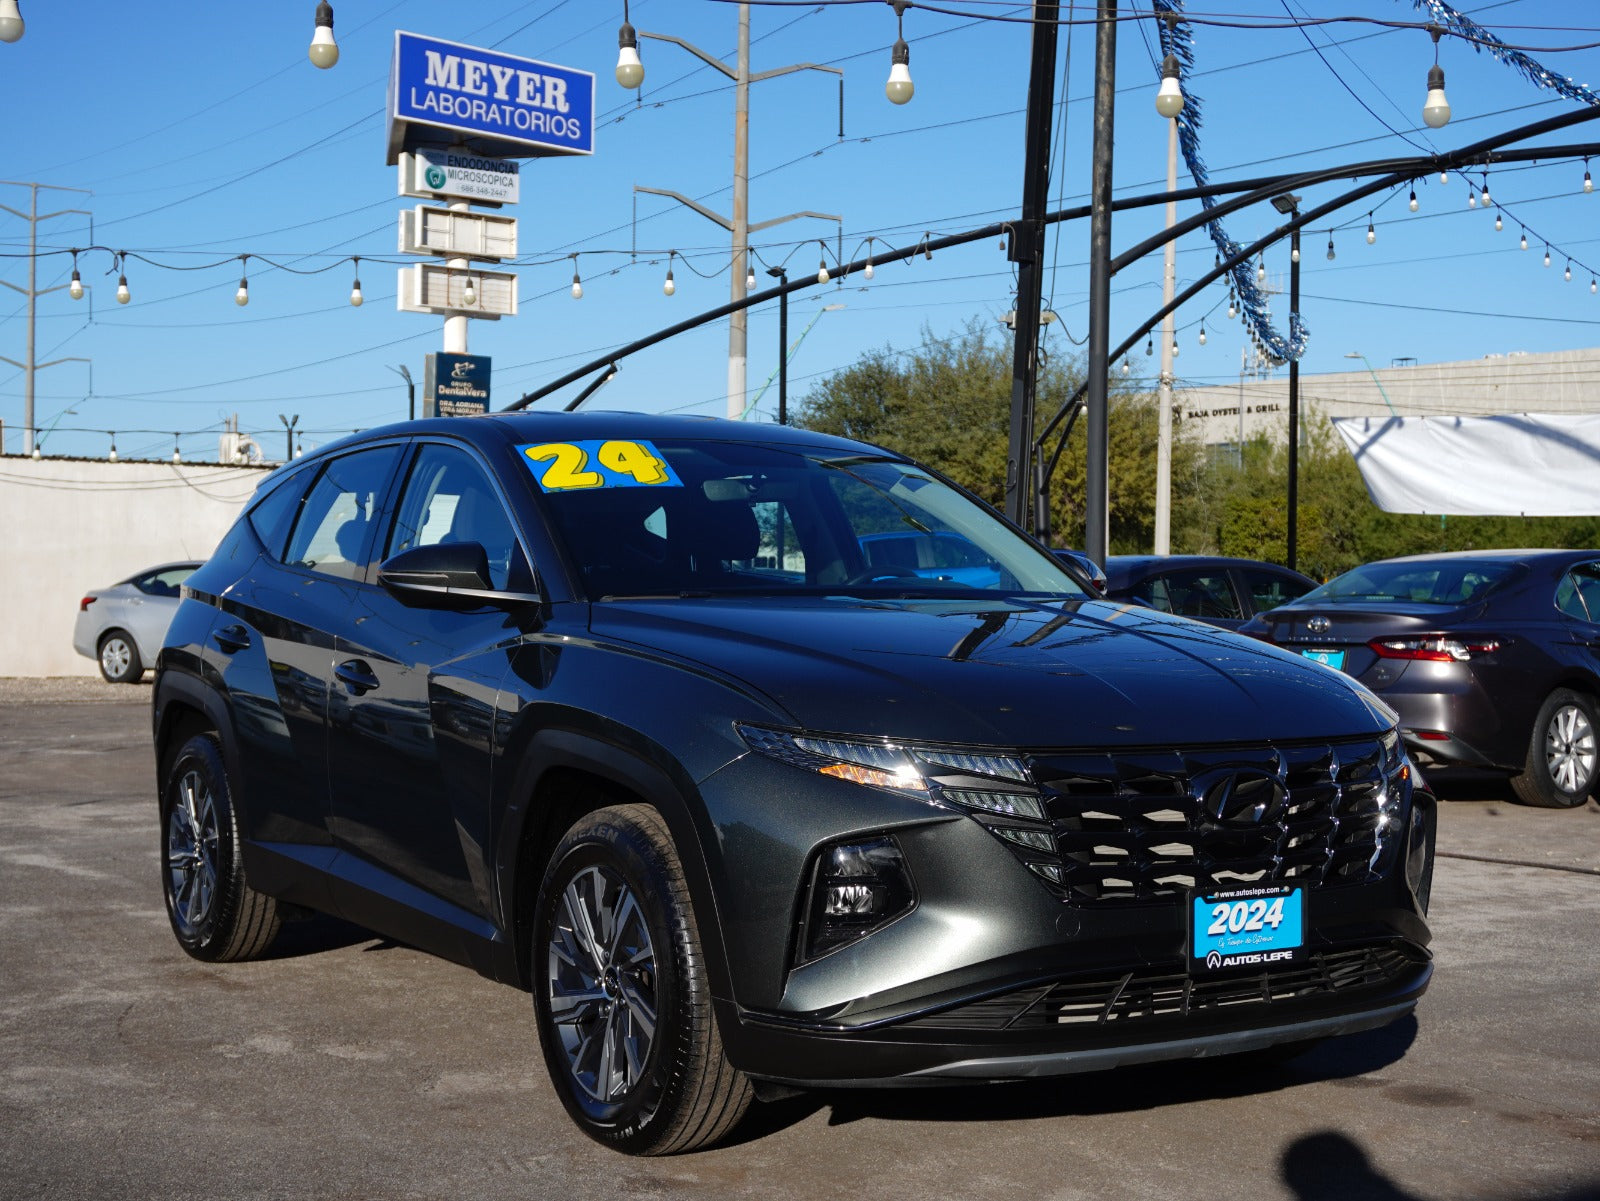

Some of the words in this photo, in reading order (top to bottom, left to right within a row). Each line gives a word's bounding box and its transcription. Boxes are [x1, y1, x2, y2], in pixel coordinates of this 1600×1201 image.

[425, 50, 570, 113] MEYER
[411, 87, 581, 139] LABORATORIOS
[447, 155, 515, 174] ENDODONCIA
[447, 168, 514, 187] MICROSCOPICA
[1188, 410, 1209, 419] BAJA
[1255, 403, 1281, 413] GRILL
[524, 440, 670, 490] 24
[1219, 887, 1280, 899] www.autoslepe.com
[1207, 897, 1285, 935] 2024
